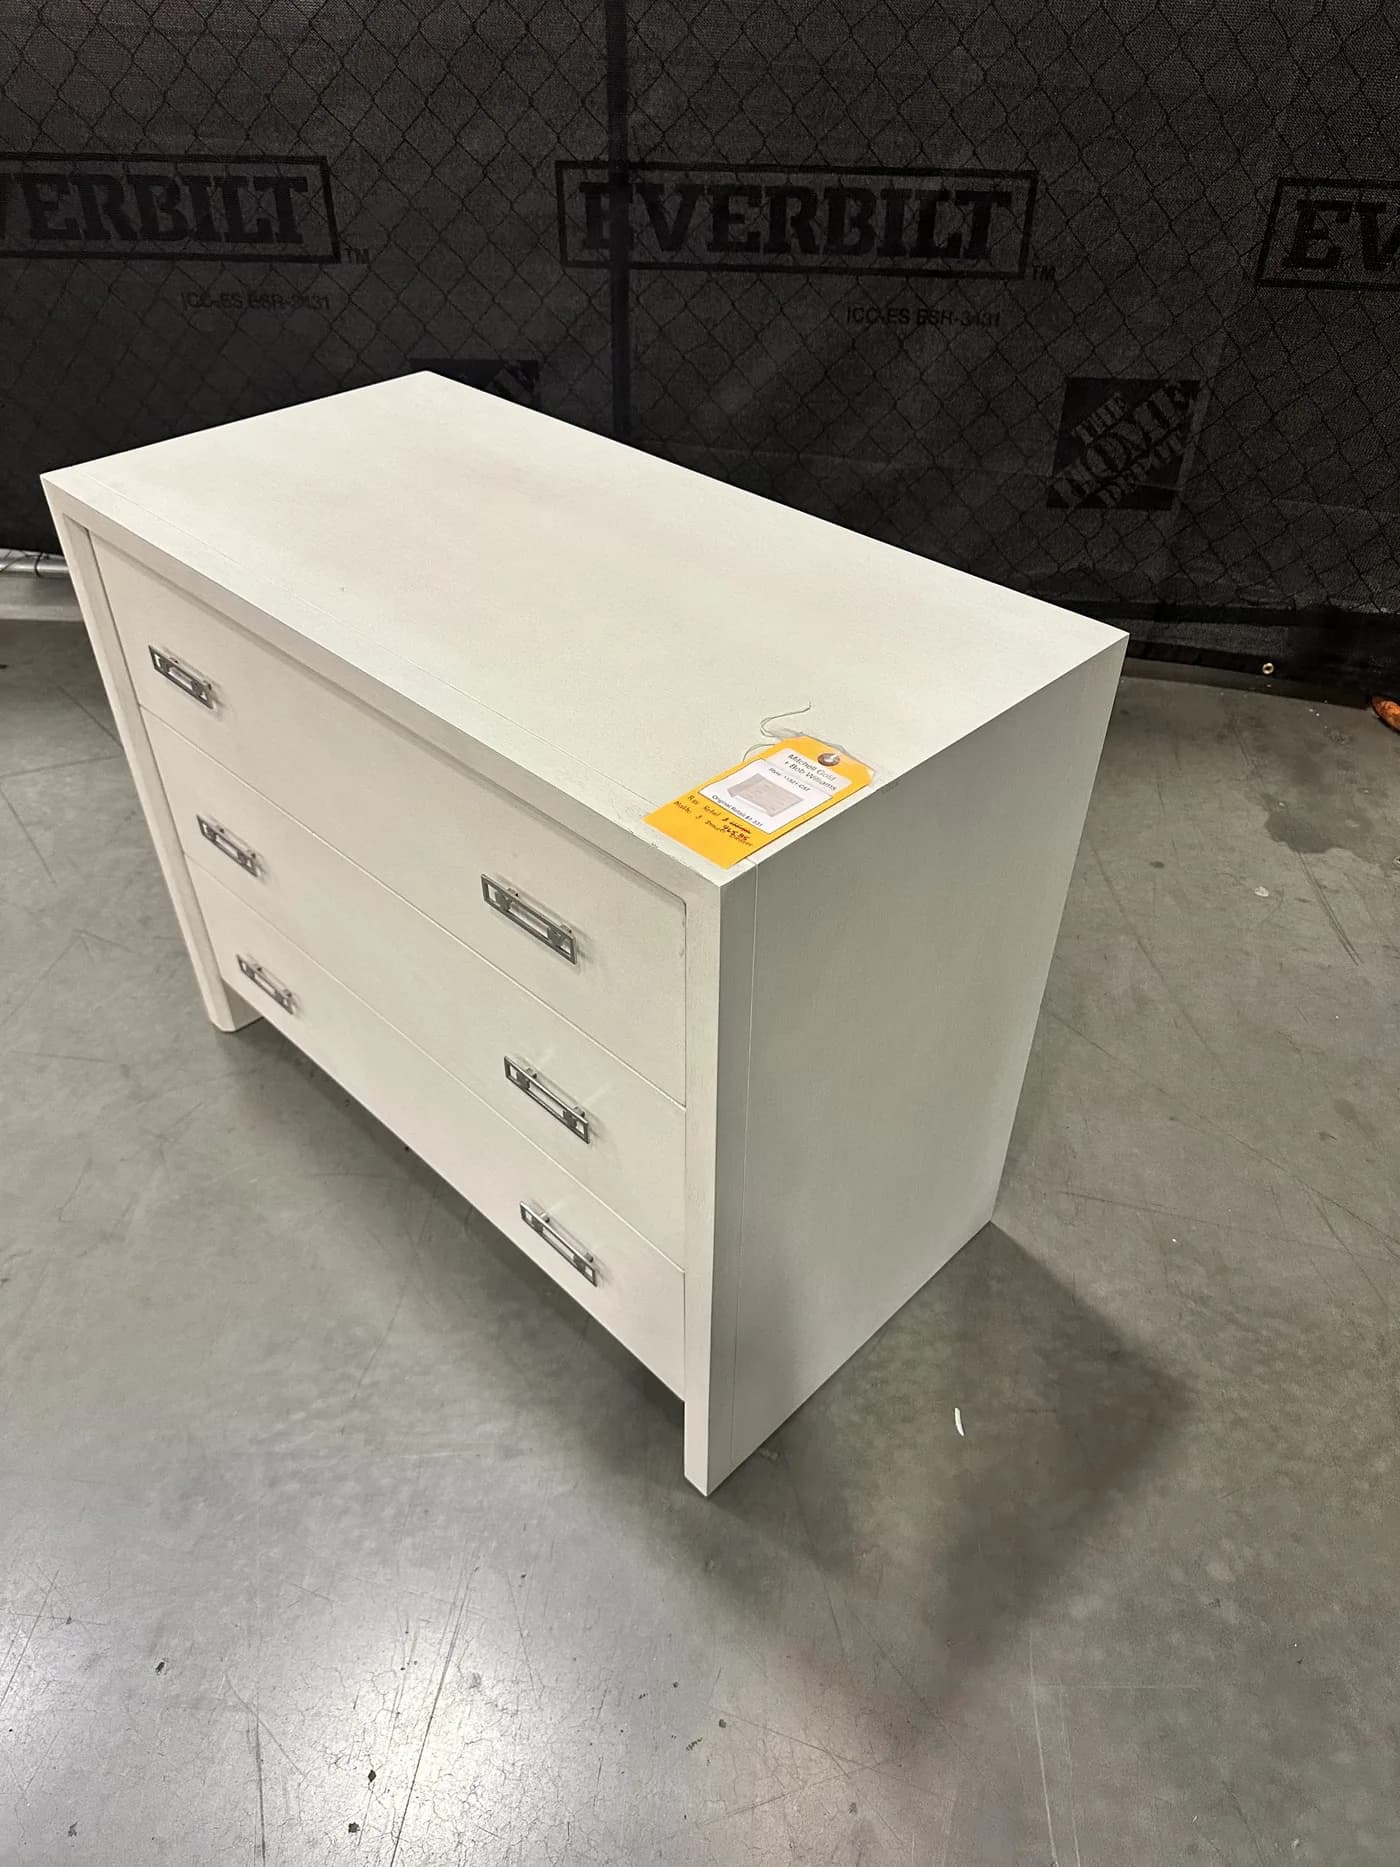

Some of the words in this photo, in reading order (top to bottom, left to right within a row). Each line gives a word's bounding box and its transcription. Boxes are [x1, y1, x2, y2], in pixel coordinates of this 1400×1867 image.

[578, 181, 1012, 260] EVERBILT
[1049, 382, 1188, 510] HOME
[1071, 391, 1128, 446] THE
[1097, 429, 1185, 508] DEPOT
[787, 753, 817, 771] Mitchell
[816, 769, 838, 781] Gold
[789, 763, 806, 775] Bob
[805, 772, 837, 791] Williams
